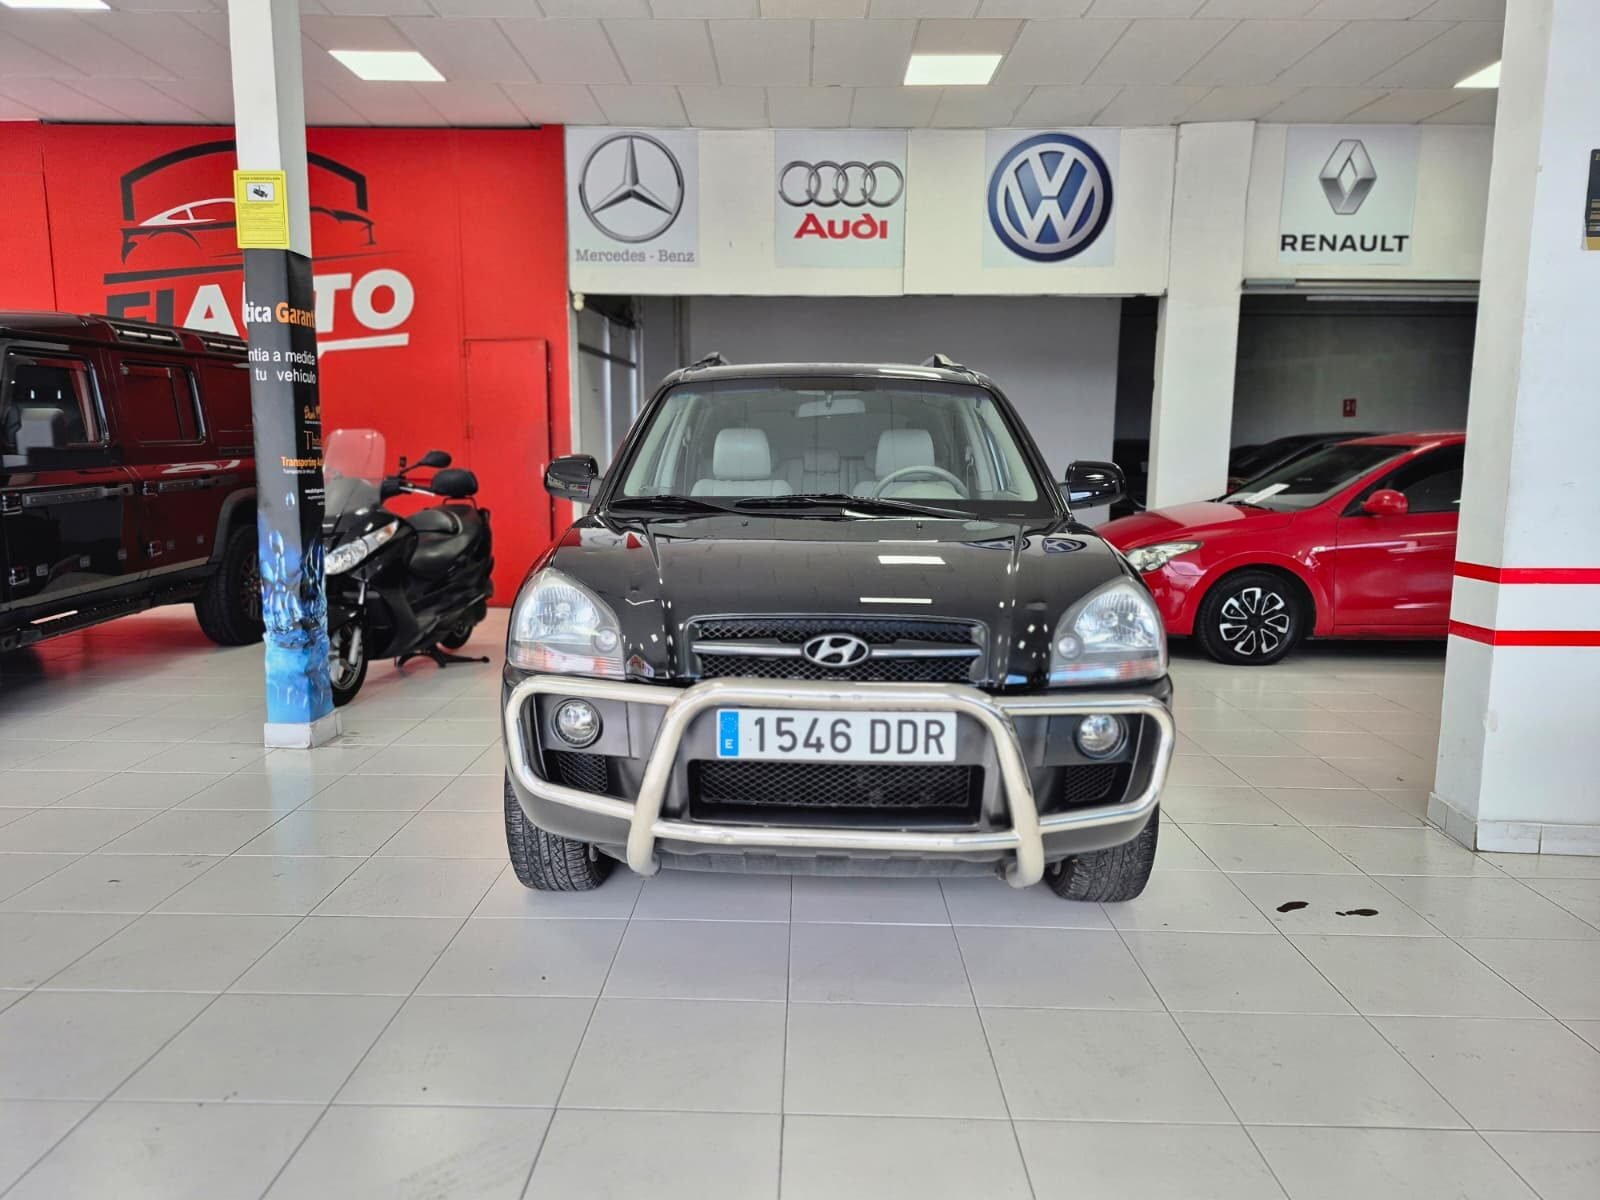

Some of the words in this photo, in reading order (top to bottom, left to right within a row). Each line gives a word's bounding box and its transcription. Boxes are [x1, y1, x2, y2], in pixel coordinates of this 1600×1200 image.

[794, 213, 888, 239] Audi
[1280, 234, 1409, 253] RENAULT
[576, 249, 646, 263] Mercedes
[658, 249, 695, 263] Benz
[273, 351, 281, 362] a
[285, 351, 316, 366] medida
[255, 368, 267, 381] tu
[725, 739, 733, 749] E
[754, 717, 852, 753] 1546
[870, 719, 945, 755] DDR
